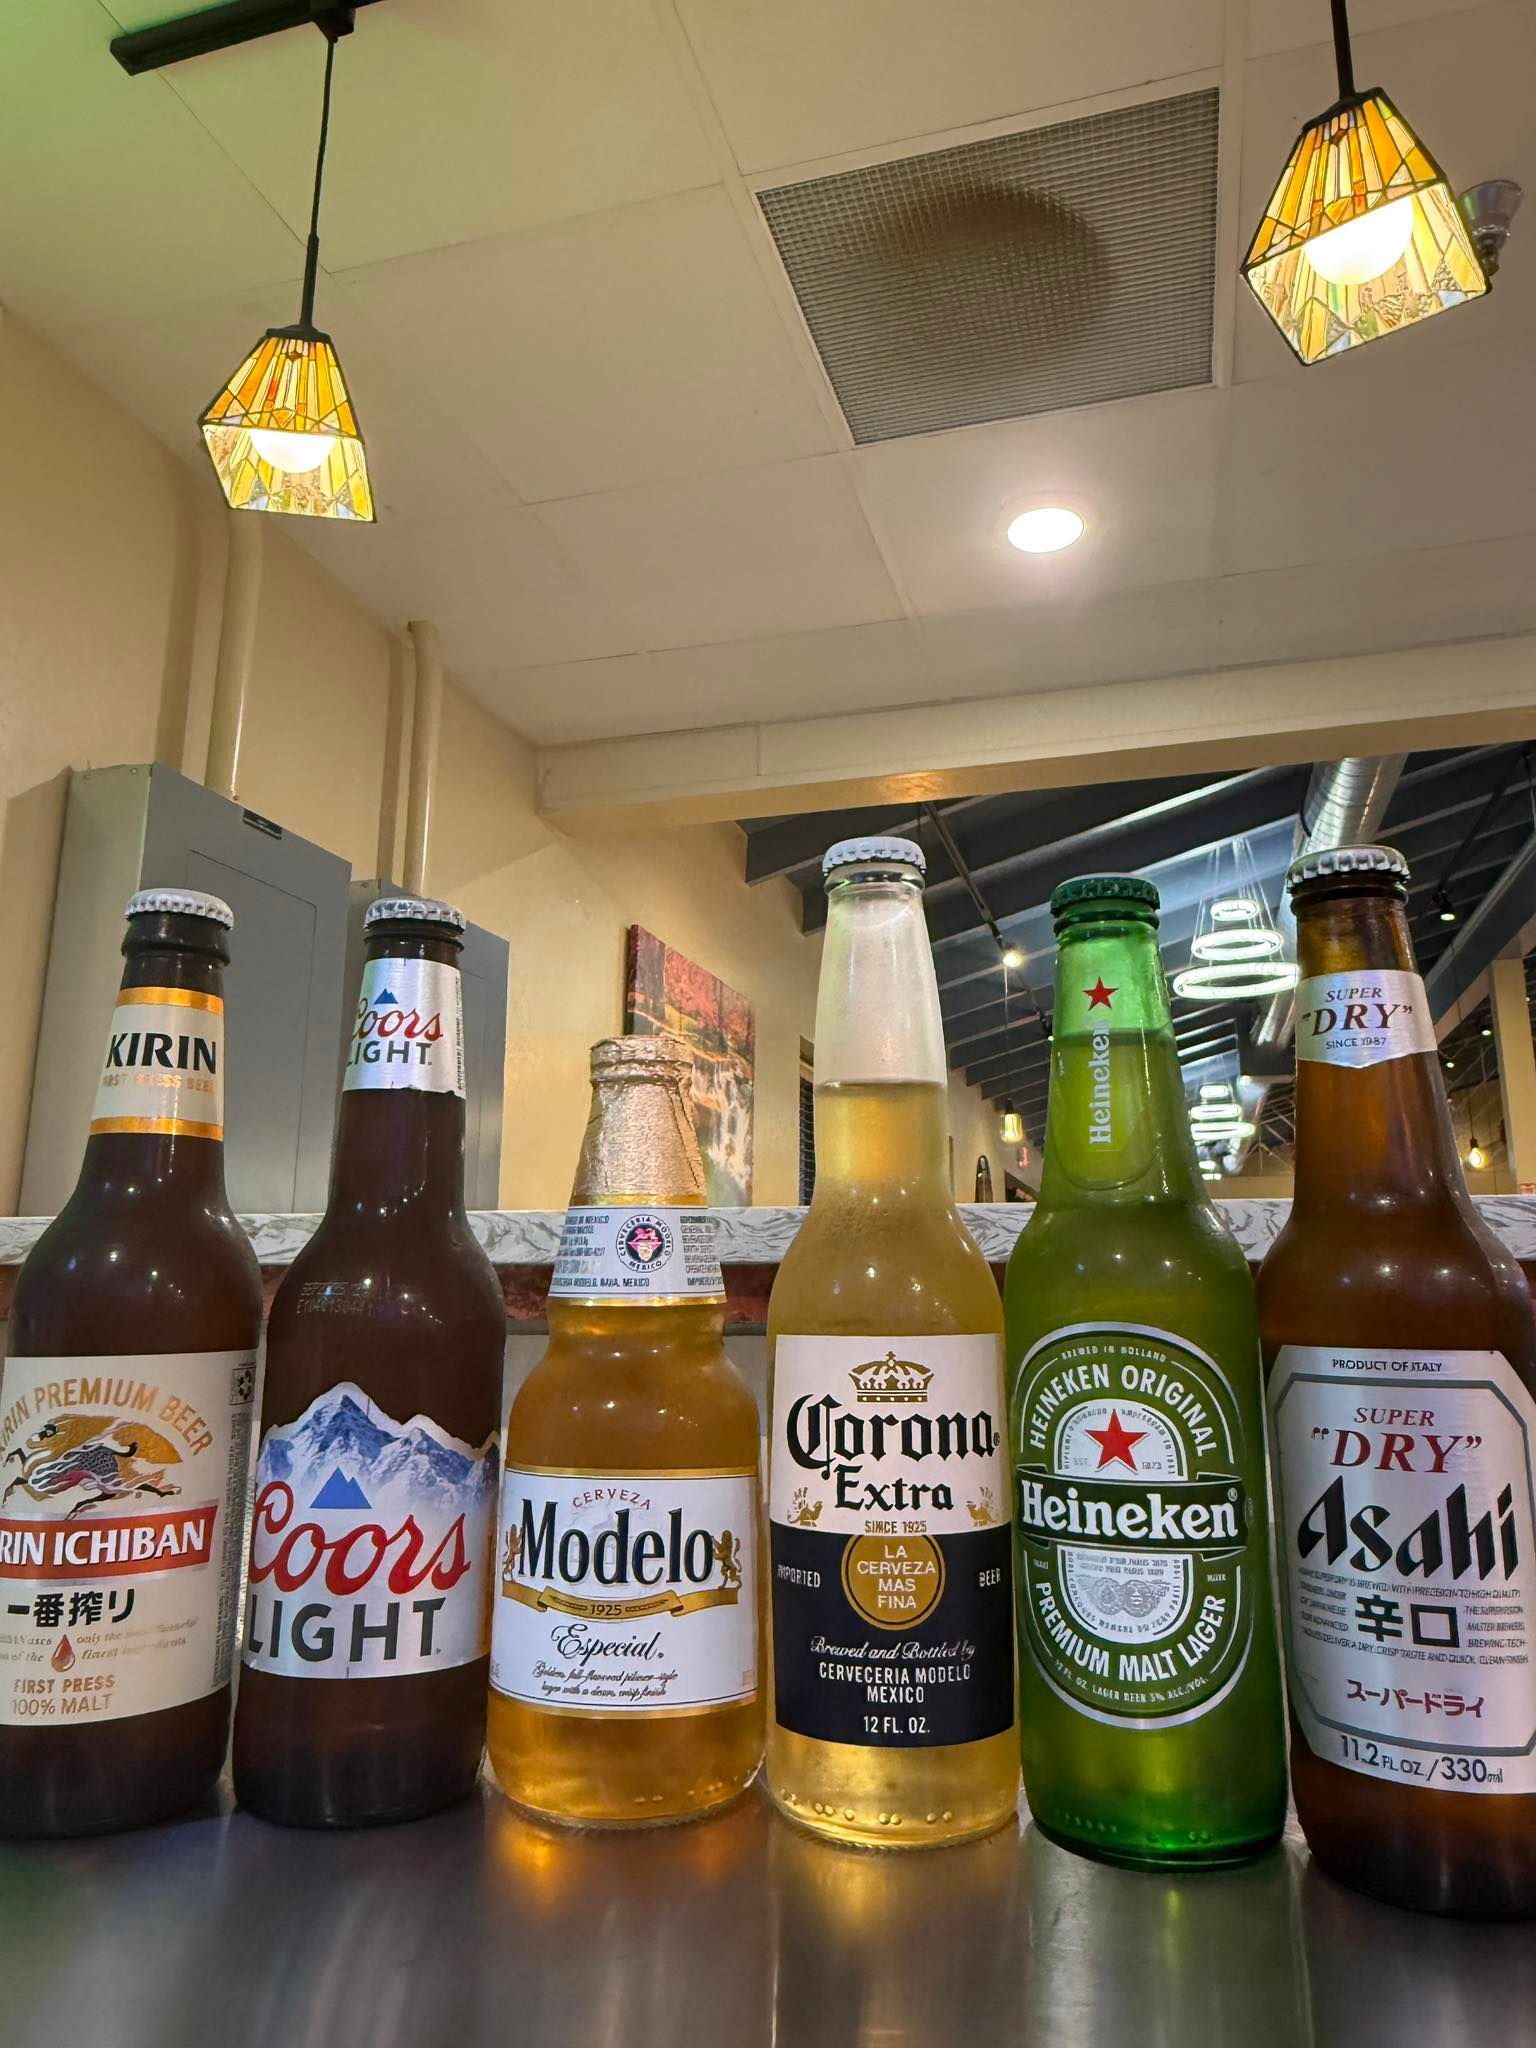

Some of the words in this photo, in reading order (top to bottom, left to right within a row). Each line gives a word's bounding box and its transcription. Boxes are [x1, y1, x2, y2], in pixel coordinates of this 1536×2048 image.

[1326, 987, 1382, 1002] SUPER
[106, 1032, 217, 1074] KIRIN
[1326, 1038, 1358, 1049] SINCE
[1088, 1019, 1112, 1144] Heineken
[1332, 1358, 1388, 1371] PRODUCT
[1391, 1361, 1408, 1371] OF
[1411, 1362, 1443, 1372] ITALY
[0, 1396, 30, 1451] IRIN
[33, 1377, 159, 1413] PREMIUM
[158, 1394, 214, 1456] BEER
[1029, 1363, 1110, 1450] HEINEKEN
[1121, 1365, 1217, 1456] ORIGINAL
[1354, 1407, 1435, 1427] SUPER
[787, 1394, 994, 1481] Corona
[572, 1488, 652, 1511] CERVEZA
[833, 1463, 954, 1511] Extra
[1021, 1480, 1239, 1539] Heineken
[249, 1481, 472, 1596] Coors
[864, 1520, 898, 1534] SINCE
[902, 1520, 927, 1534] 1925
[1297, 1475, 1519, 1581] Asahi
[53, 1519, 206, 1566] ICHIBAN
[518, 1498, 714, 1585] Modelo
[884, 1545, 908, 1559] LA
[857, 1561, 936, 1575] CERVEZA
[878, 1578, 917, 1592] MAS
[7, 1588, 135, 1628] 一番搾り
[590, 1604, 623, 1616] 1925
[877, 1594, 917, 1609] FINA
[249, 1597, 446, 1663] LIGHT
[1036, 1582, 1110, 1678] PREMIUM
[1119, 1648, 1178, 1682] MALT
[1177, 1594, 1226, 1668] LAGER
[1354, 1593, 1460, 1648] 辛口
[810, 1635, 869, 1659] Brewed
[868, 1642, 902, 1659] and
[902, 1641, 961, 1660] Bottled
[961, 1639, 976, 1662] by
[14, 1678, 56, 1695] FIRST
[62, 1674, 115, 1694] PRESS
[819, 1661, 910, 1685] CERVECERIA
[915, 1664, 971, 1684] MODELO
[13, 1698, 56, 1716] 100%
[61, 1693, 113, 1715] MALT
[867, 1686, 925, 1704] MEXICO
[1347, 1679, 1484, 1718] スーパードライ
[863, 1715, 879, 1733] 12
[884, 1716, 904, 1734] FL.
[908, 1716, 931, 1734] OZ.
